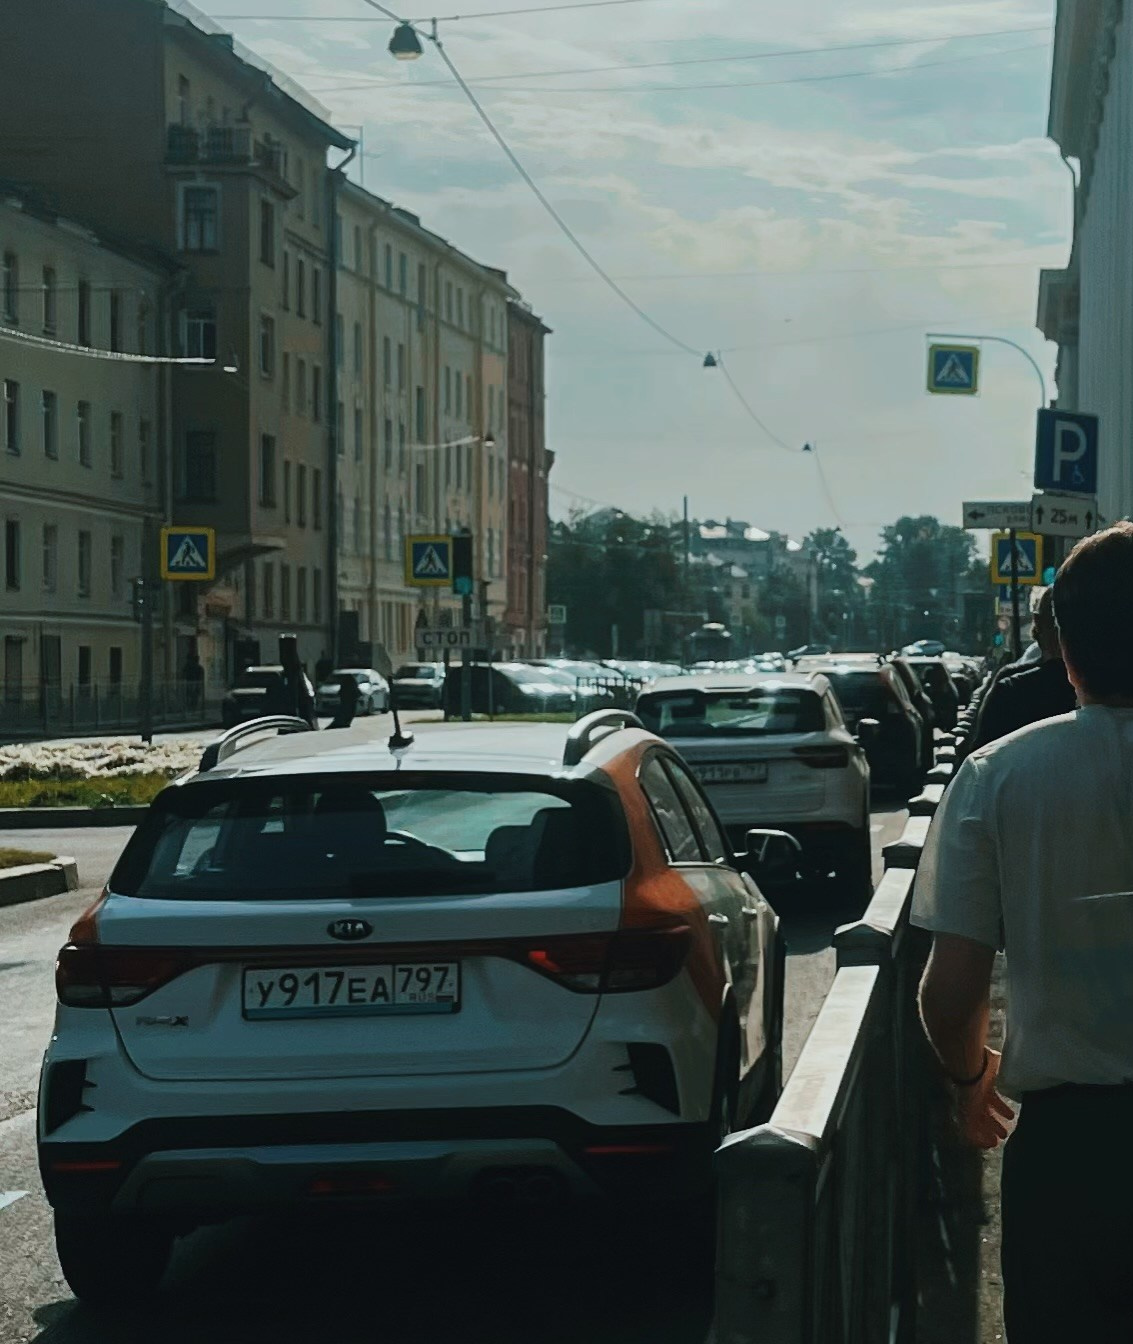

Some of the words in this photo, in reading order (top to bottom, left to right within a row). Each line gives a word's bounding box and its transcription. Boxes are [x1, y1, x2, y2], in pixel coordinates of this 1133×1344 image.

[1053, 420, 1087, 482] P
[423, 631, 470, 644] СТОП
[333, 921, 366, 934] KIA
[398, 966, 448, 992] 797
